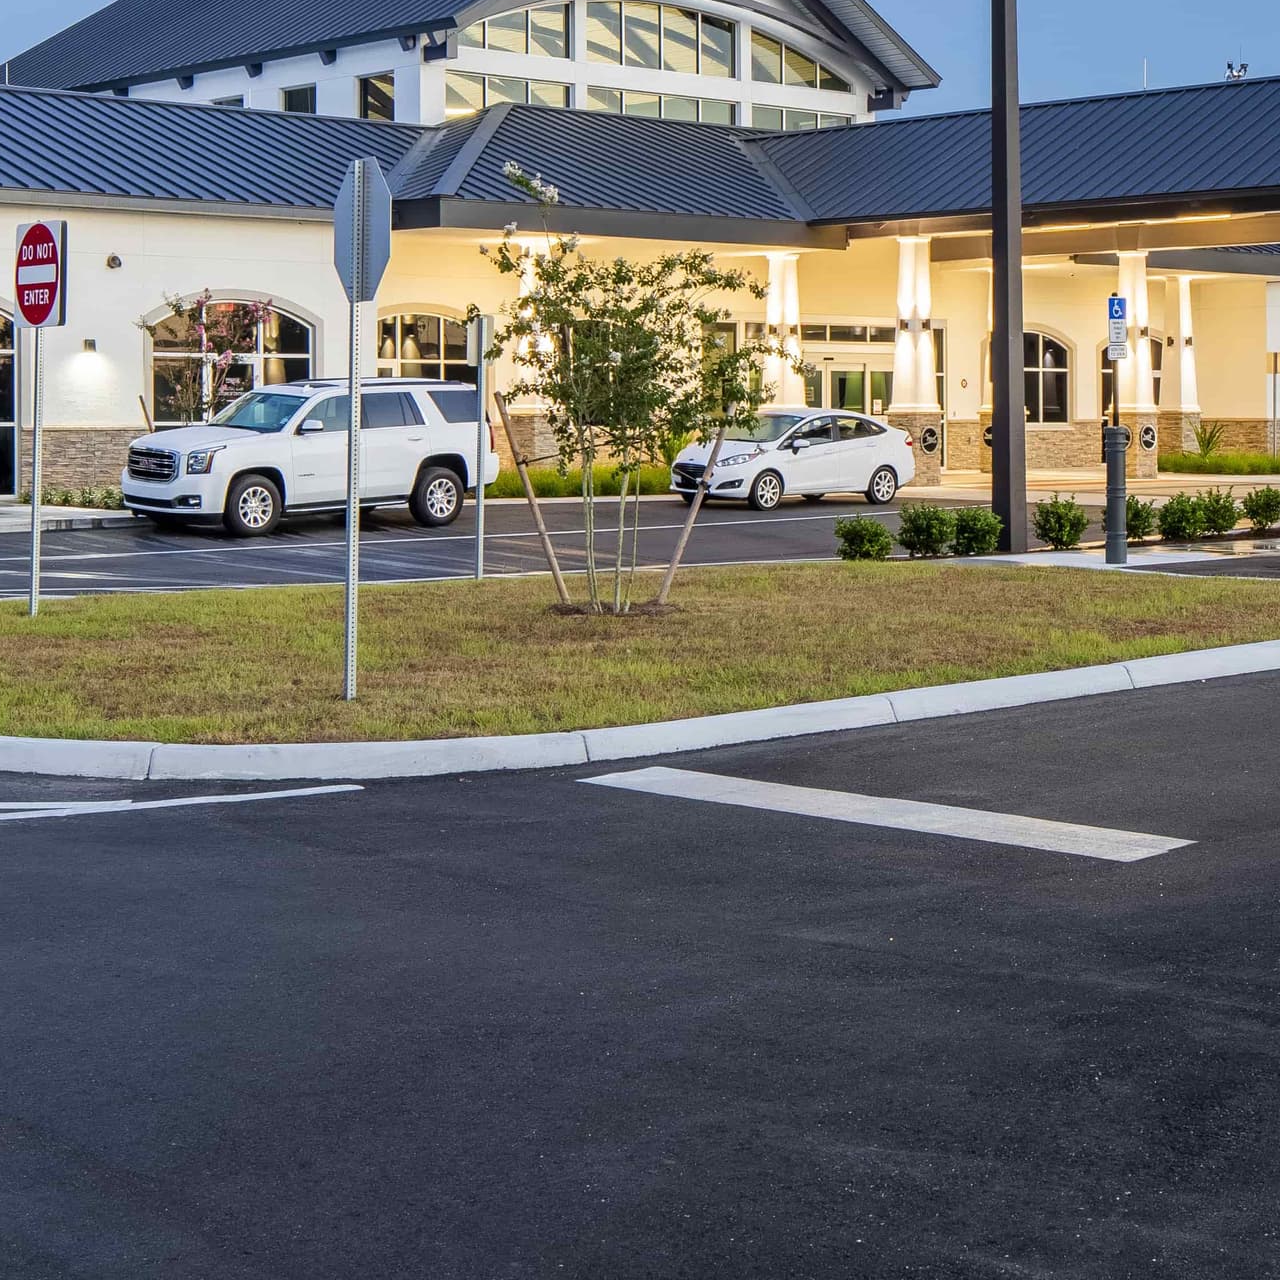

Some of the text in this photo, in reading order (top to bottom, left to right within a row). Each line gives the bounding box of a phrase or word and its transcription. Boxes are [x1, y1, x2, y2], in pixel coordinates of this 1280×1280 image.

[22, 243, 54, 261] DO NOT
[24, 289, 50, 306] ENTER
